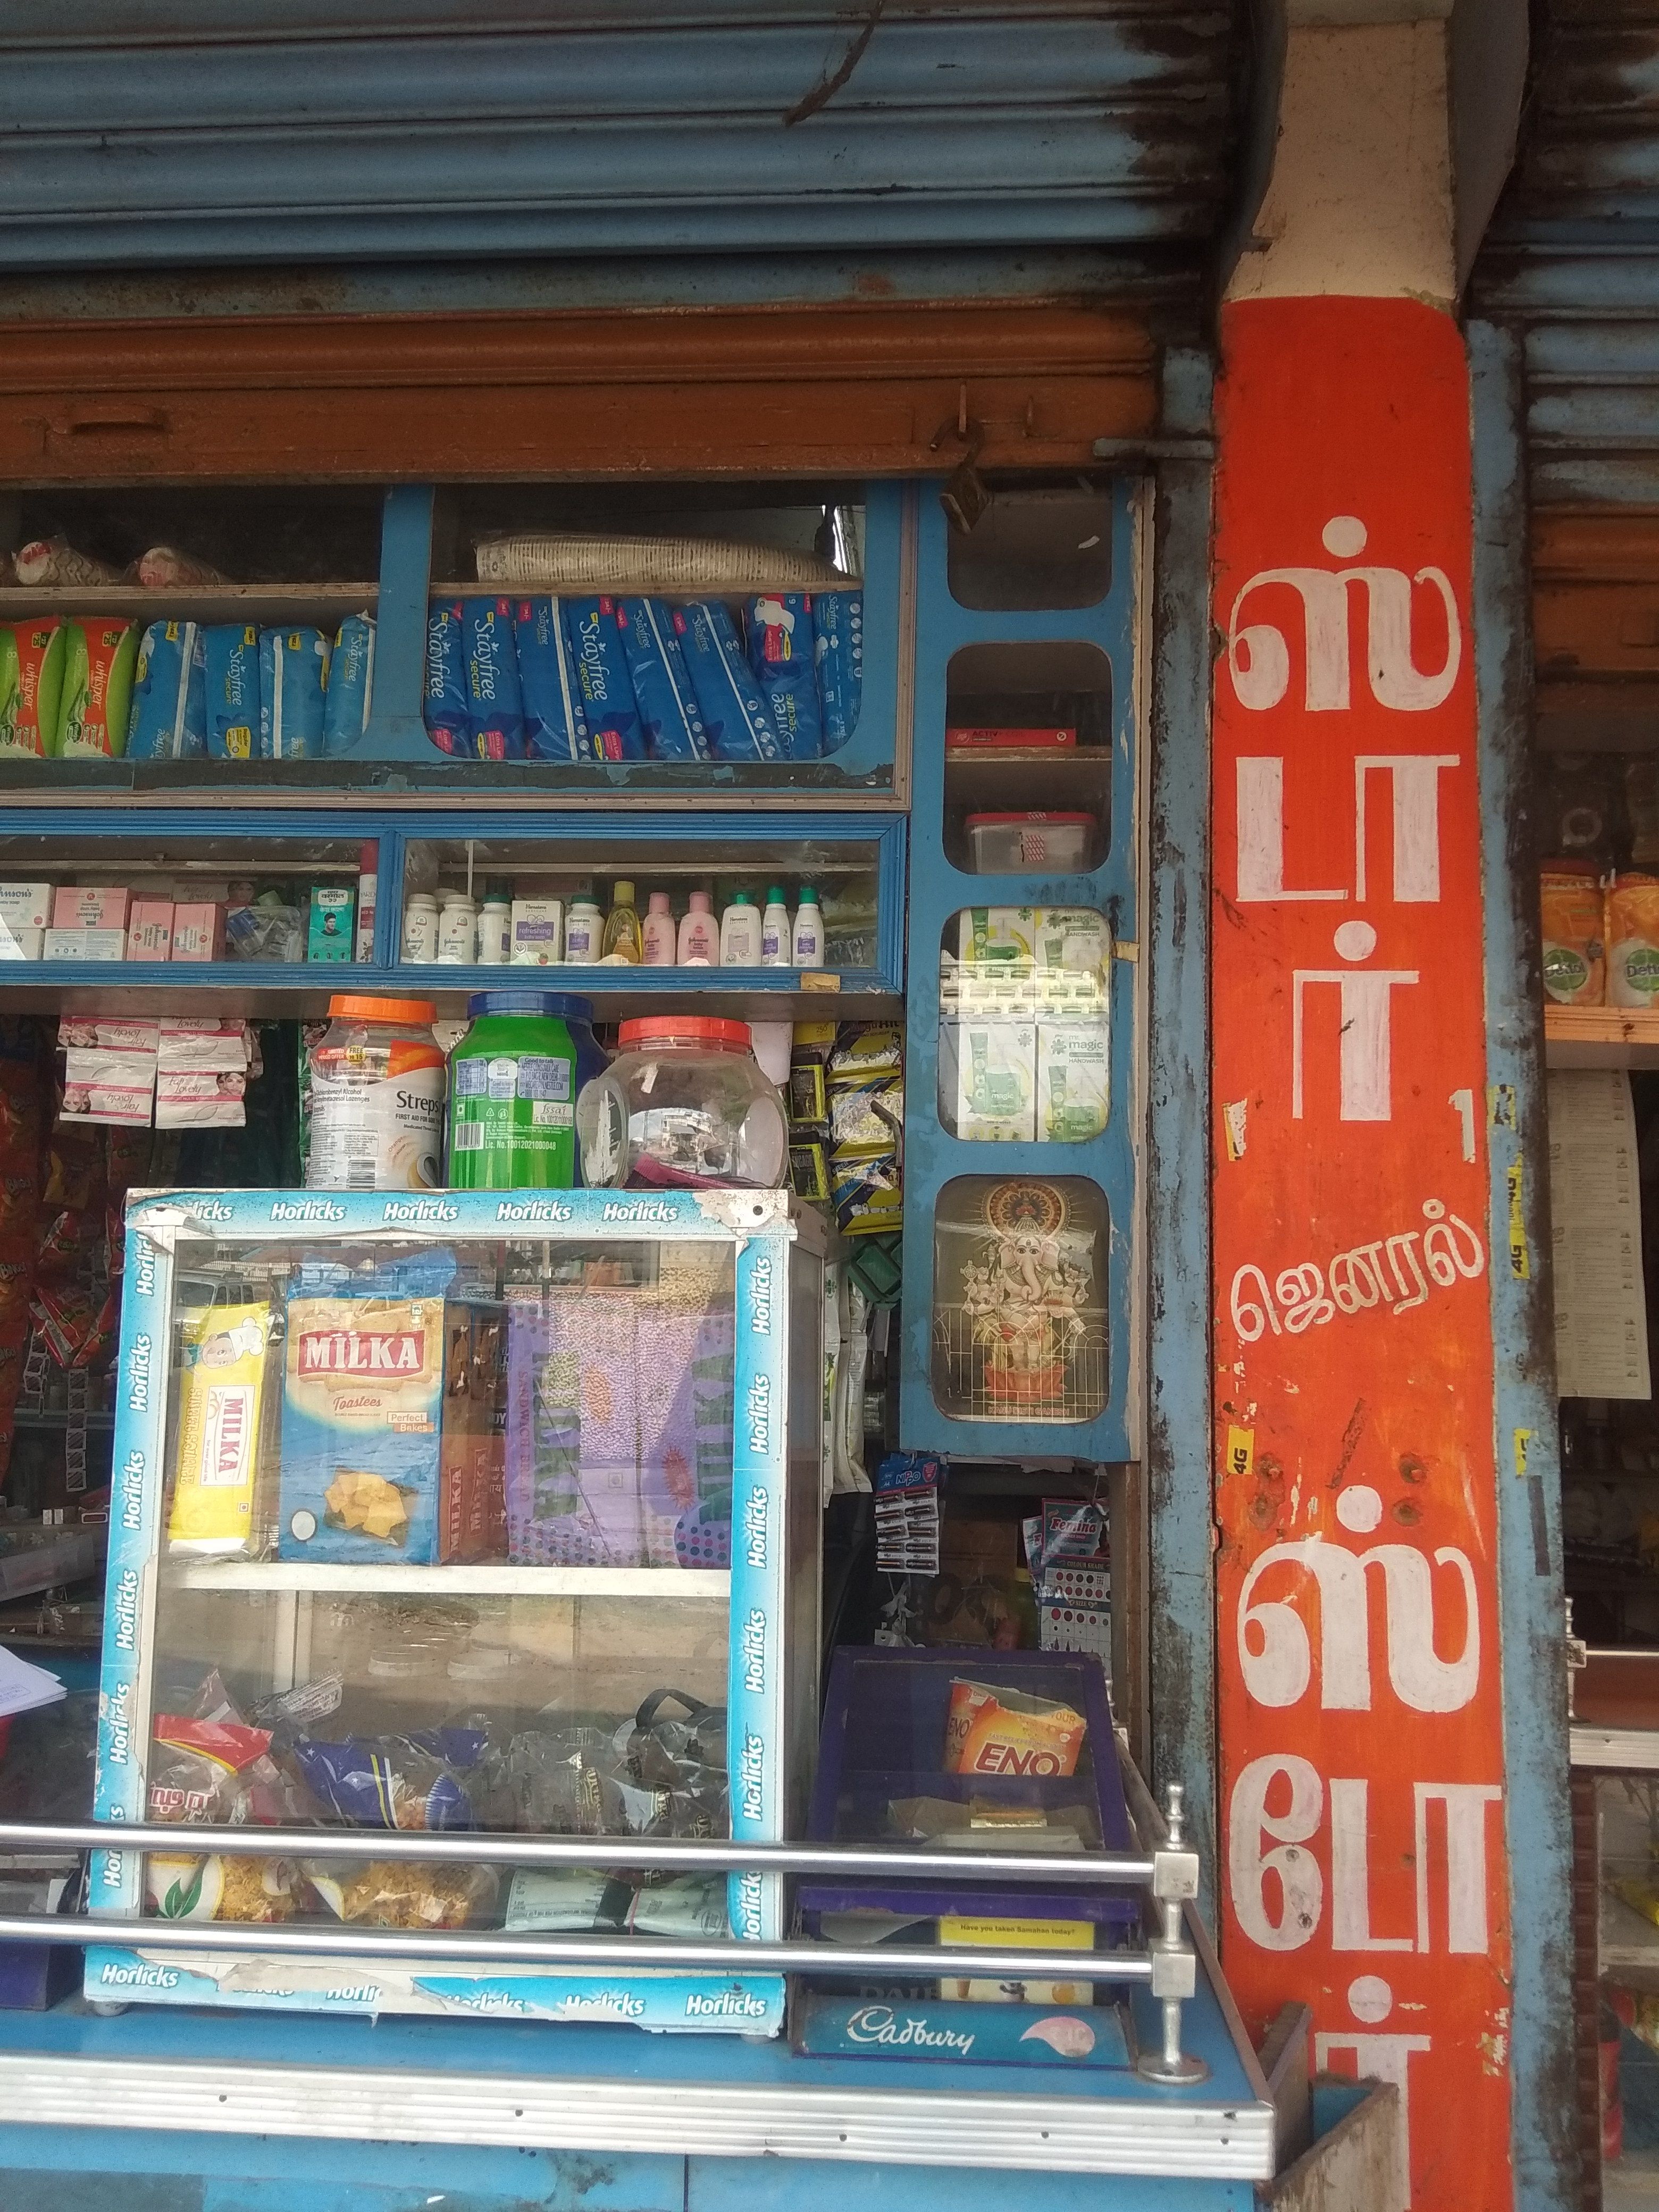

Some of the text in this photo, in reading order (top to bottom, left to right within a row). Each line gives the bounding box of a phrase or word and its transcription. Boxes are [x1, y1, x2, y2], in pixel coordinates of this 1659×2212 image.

[537, 608, 550, 646] Stayfree
[828, 595, 839, 630] Stayfree
[631, 611, 651, 649] Stayfree
[692, 616, 710, 652] Stayfree
[347, 637, 363, 683] Stayfree
[426, 617, 451, 700] Stayfree
[473, 618, 501, 700] Stayfree
[579, 621, 610, 701] Stayfree
[23, 662, 39, 712] whisper
[91, 659, 108, 710] whisper
[228, 648, 246, 706] Stayfree
[470, 659, 482, 700] secure
[579, 661, 594, 701] secure
[786, 692, 797, 733] secure
[76, 909, 104, 920] Johnson's
[152, 923, 163, 952] Johnson's
[443, 937, 466, 946] Johnson's
[518, 927, 551, 936] refreshing
[688, 937, 709, 946] Johnson's
[113, 1027, 141, 1038] Lovely
[177, 1019, 203, 1029] Lovely
[127, 1037, 146, 1047] Fair
[1069, 1039, 1104, 1052] magic
[168, 1076, 188, 1086] Fair
[175, 1084, 202, 1094] Lovely
[106, 1093, 133, 1104] Lovely
[122, 1103, 140, 1112] Fair
[346, 1095, 371, 1104] Lozenges
[540, 1103, 566, 1116] fssai
[395, 1113, 410, 1121] FIRST
[388, 1136, 404, 1153] Orange
[485, 1140, 494, 1149] Lic.
[831, 1161, 849, 1175] SUPER
[270, 1199, 680, 1222] Horlicks Horlicks Horlicks Horlicks
[1230, 1198, 1484, 1343] ஜெனரல்
[1511, 1244, 1523, 1274] 4G
[751, 1254, 773, 1337] Horlicks
[305, 1336, 421, 1369] MILKA
[129, 1333, 153, 1414] Horlicks
[333, 1396, 383, 1411] Toastees
[391, 1413, 424, 1422] Perfect
[519, 1371, 530, 1447] SANDWICH
[748, 1372, 770, 1456] Horlicks
[180, 1387, 203, 1486] SWEET SQUARE
[218, 1397, 244, 1473] MILKA
[400, 1423, 428, 1432] Bakes
[1233, 1447, 1248, 1474] 4G
[122, 1449, 145, 1531] Horlicks
[895, 1470, 922, 1487] NIPPO
[450, 1469, 463, 1553] MILKA
[1049, 1518, 1097, 1534] Femina
[746, 1485, 769, 1570] Horlicks
[115, 1568, 139, 1650] Horlicks
[744, 1608, 766, 1695] Horlicks
[947, 1717, 970, 1739] ENO
[974, 1740, 1061, 1775] ENO
[742, 1733, 765, 1822] Horlicks
[1051, 1927, 1076, 1936] today?
[99, 1962, 179, 1989] Horlicks
[685, 1992, 767, 2017] Horlicks
[847, 2004, 976, 2056] Cadbury
